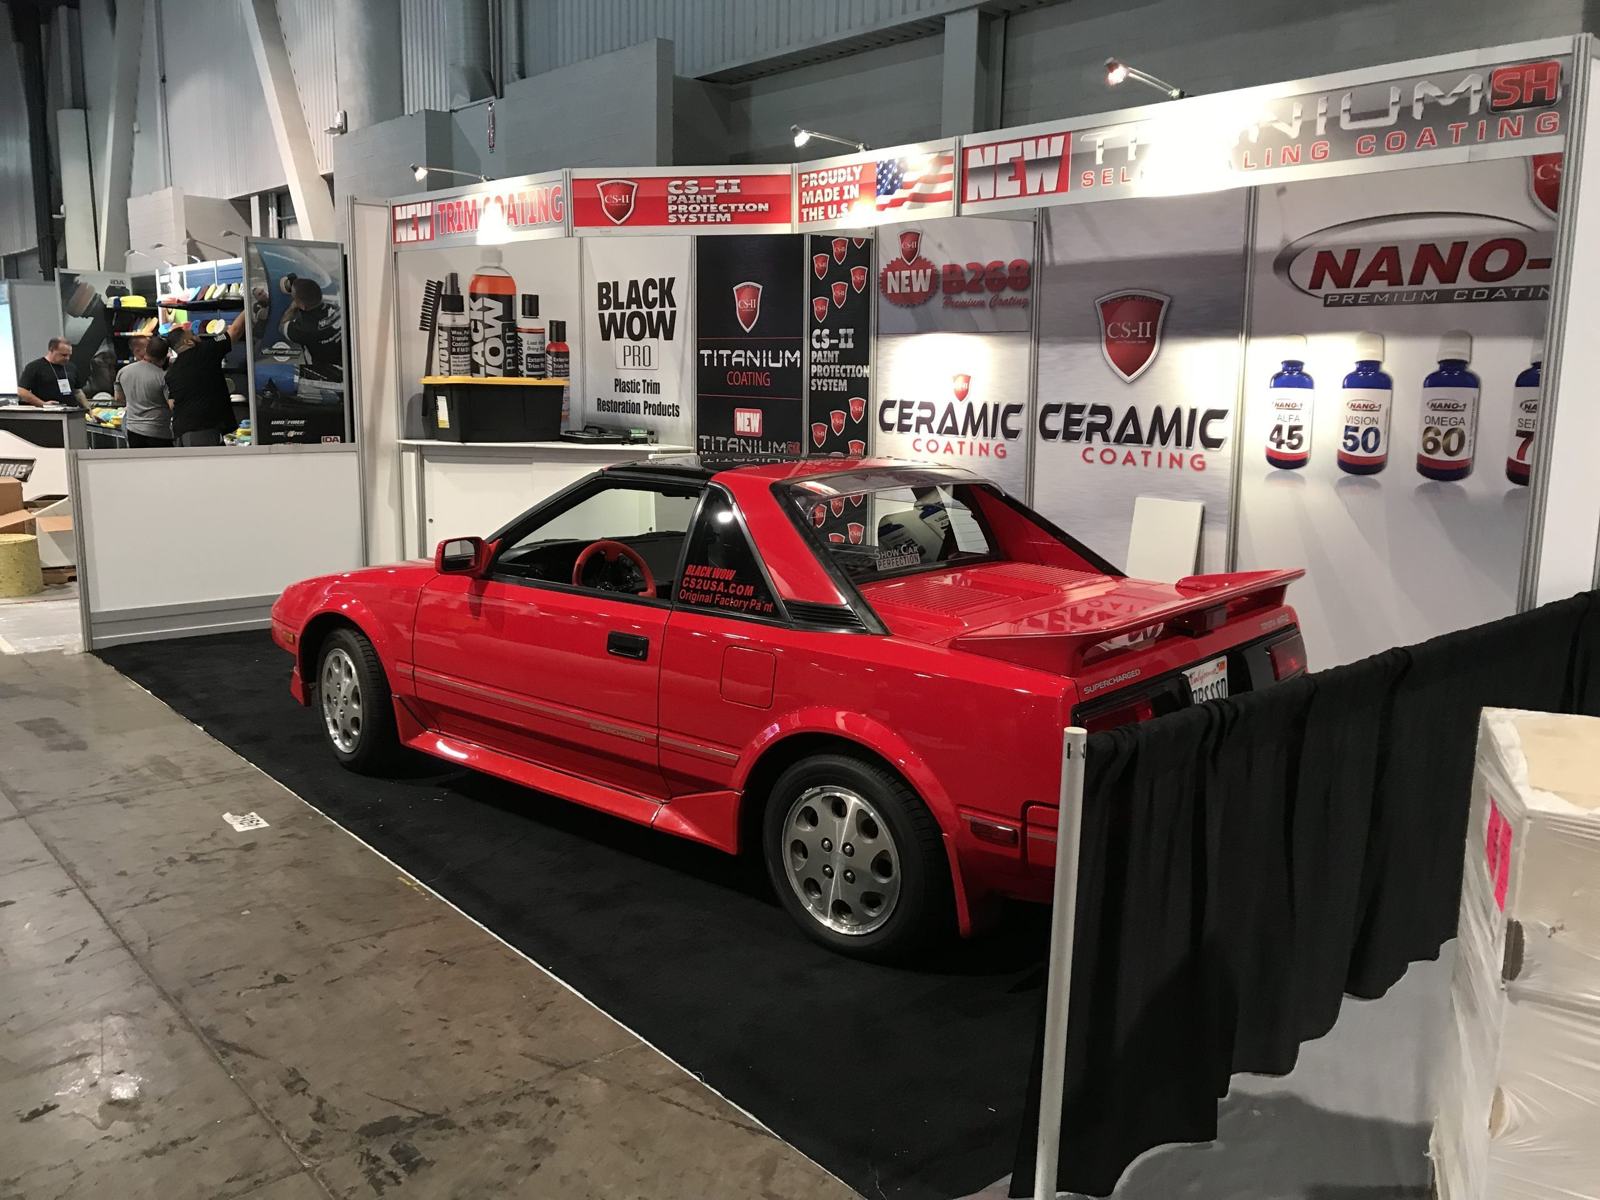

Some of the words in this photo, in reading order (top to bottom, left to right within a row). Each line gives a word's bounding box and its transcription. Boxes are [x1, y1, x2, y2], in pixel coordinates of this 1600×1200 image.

[1493, 69, 1557, 106] SH
[1356, 111, 1560, 156] COATING
[801, 165, 863, 188] PROUDLY
[967, 135, 1065, 198] NEW
[667, 179, 741, 194] CS-II
[802, 187, 838, 205] MADE
[842, 184, 860, 199] IN
[604, 194, 629, 204] CS-II
[668, 195, 717, 204] PAINT
[668, 203, 769, 213] PROTECTION
[395, 202, 432, 243] NEW
[438, 200, 478, 235] TRIM
[668, 213, 731, 223] SYSTEM
[801, 205, 824, 222] THE
[1308, 238, 1552, 290] NANO-
[887, 268, 931, 294] NEW
[597, 277, 677, 311] BLACK
[1326, 289, 1438, 305] PREMIUM
[1453, 285, 1552, 301] COATIN
[598, 310, 677, 341] WOW
[1107, 321, 1152, 339] CS-II
[811, 328, 854, 349] CS-II
[623, 345, 651, 367] PRO
[699, 350, 801, 368] TITANIUM
[811, 351, 840, 363] PAINT
[726, 370, 771, 387] COATING
[810, 365, 869, 378] PROTECTION
[614, 378, 640, 394] Plastic
[642, 379, 661, 394] Trim
[810, 379, 848, 392] SYSTEM
[597, 397, 641, 415] Restoration
[643, 400, 680, 418] Products
[736, 411, 761, 433] NEW
[879, 399, 1024, 440] CERAMIC
[1038, 402, 1230, 449] CERAMIC
[1345, 415, 1379, 425] VISION
[1424, 415, 1466, 426] OMEGA
[699, 435, 786, 455] TITANIUM
[1269, 424, 1304, 450] 45
[1342, 425, 1381, 453] 50
[1422, 426, 1466, 457] 60
[1515, 430, 1535, 461] 7
[912, 438, 1007, 460] COATING
[1081, 446, 1208, 472] COATING
[685, 564, 711, 577] BLACK
[711, 567, 736, 580] WOW
[682, 577, 754, 597] CS2USA.COM
[680, 589, 713, 604] Original
[714, 594, 749, 611] Factory
[1083, 668, 1141, 695] SUPERCHARGED
